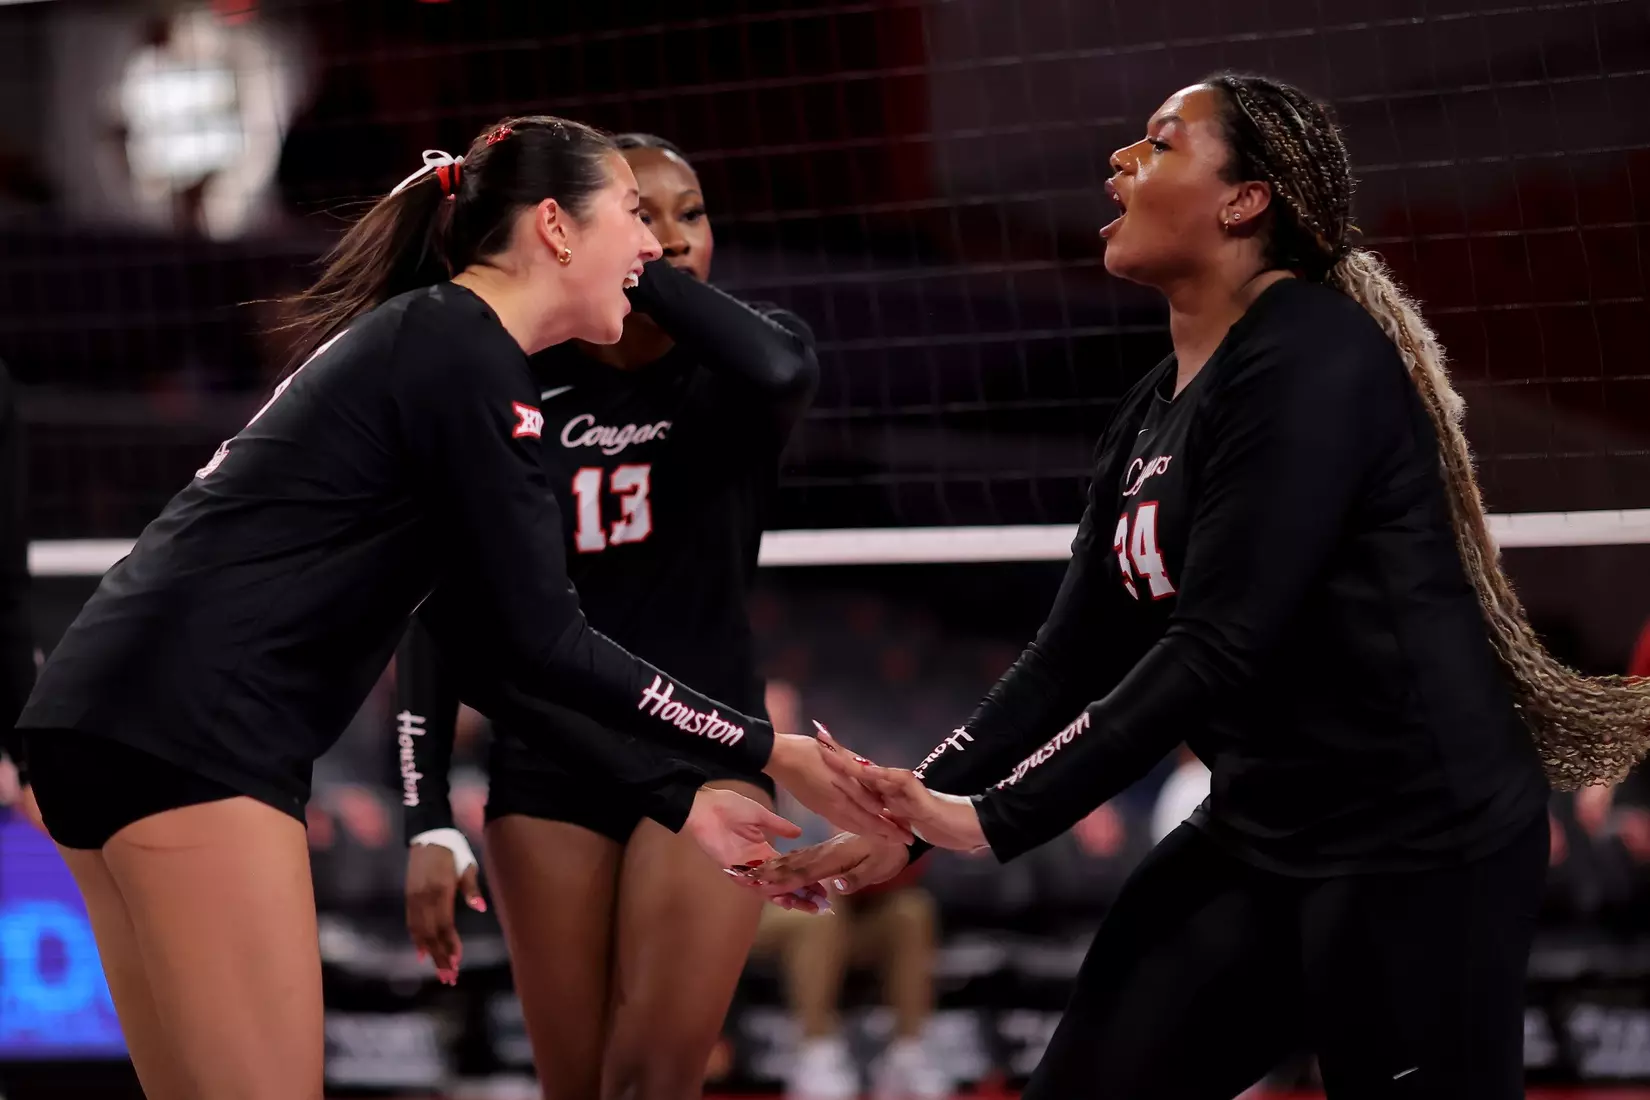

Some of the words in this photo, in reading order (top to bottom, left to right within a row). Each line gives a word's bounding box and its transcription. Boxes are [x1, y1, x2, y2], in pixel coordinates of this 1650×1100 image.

[571, 463, 652, 552] 13
[637, 674, 745, 747] Houston
[396, 709, 426, 807] Houston
[912, 725, 975, 780] Houst
